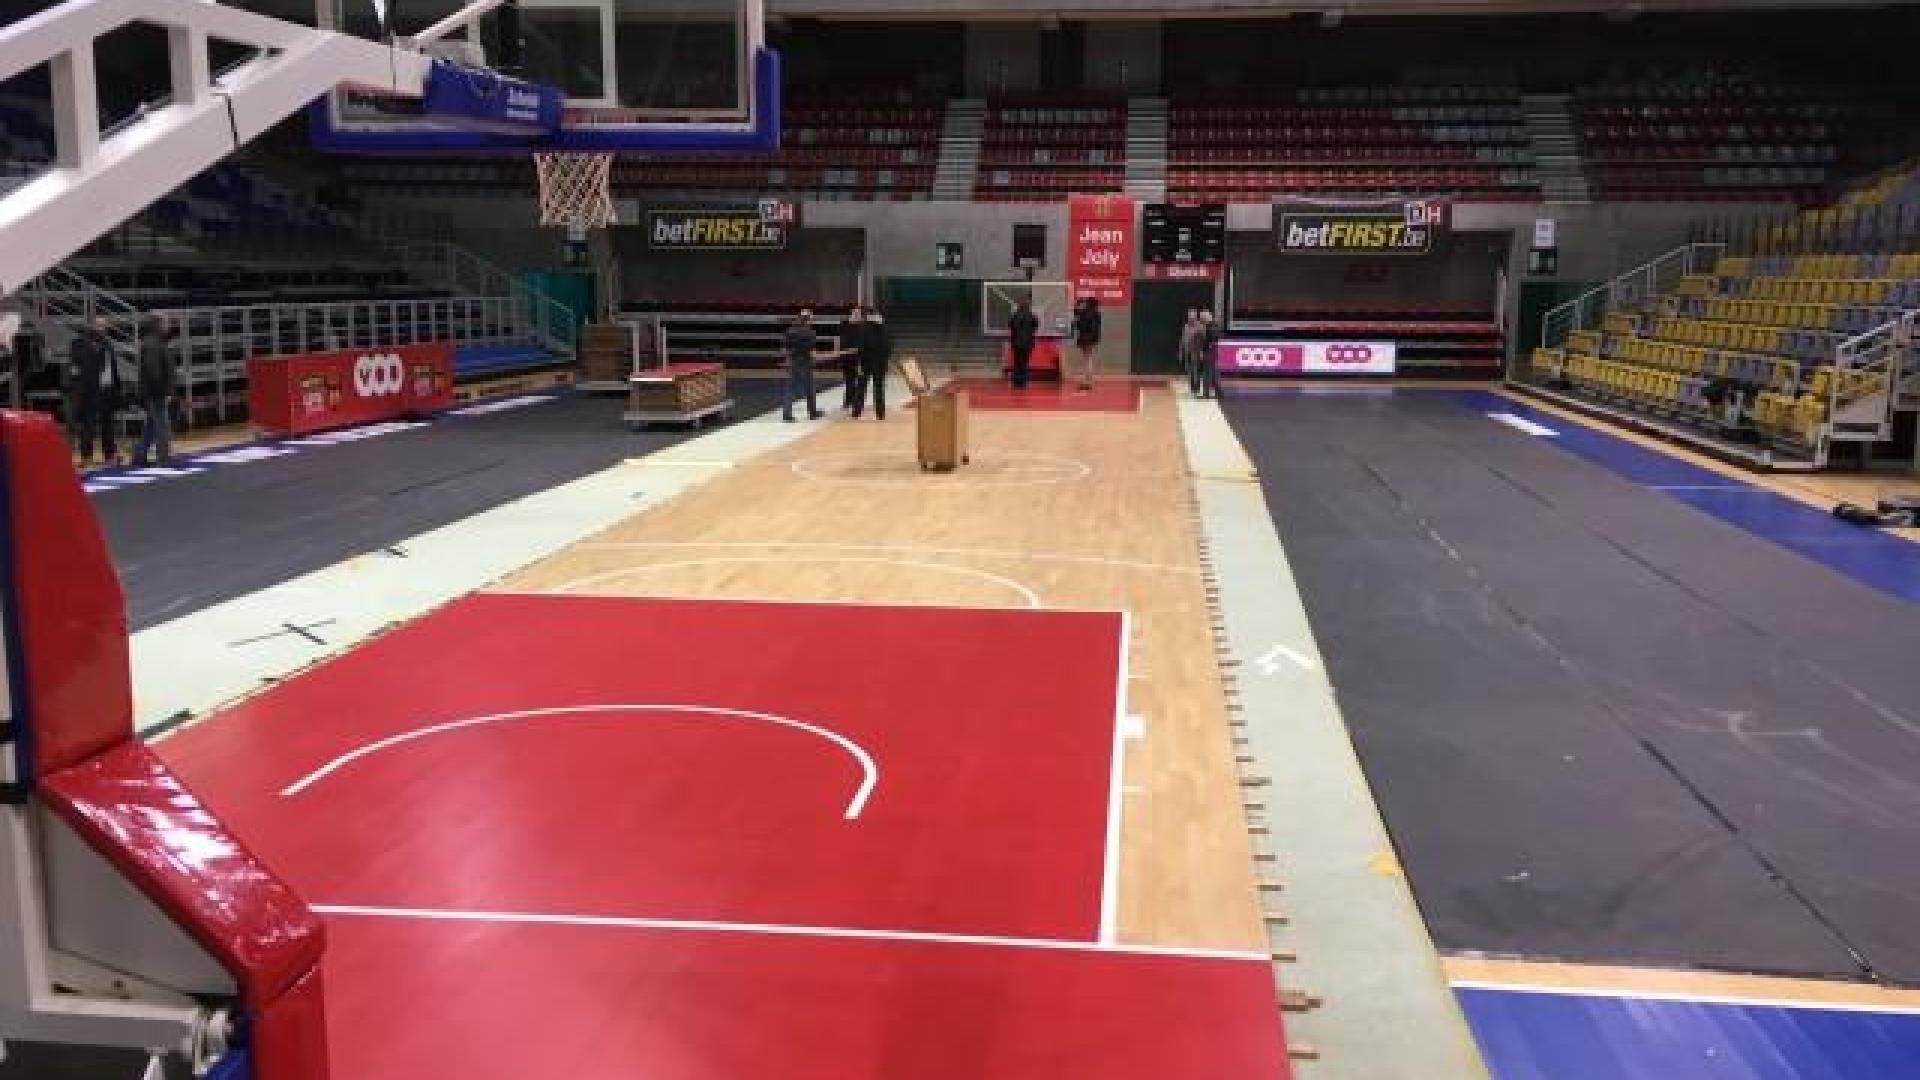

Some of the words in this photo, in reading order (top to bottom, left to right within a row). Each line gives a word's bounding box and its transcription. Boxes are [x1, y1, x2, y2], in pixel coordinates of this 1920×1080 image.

[1079, 224, 1123, 244] Jean
[1286, 221, 1426, 247] betFIRST.be
[1079, 249, 1120, 272] Joly
